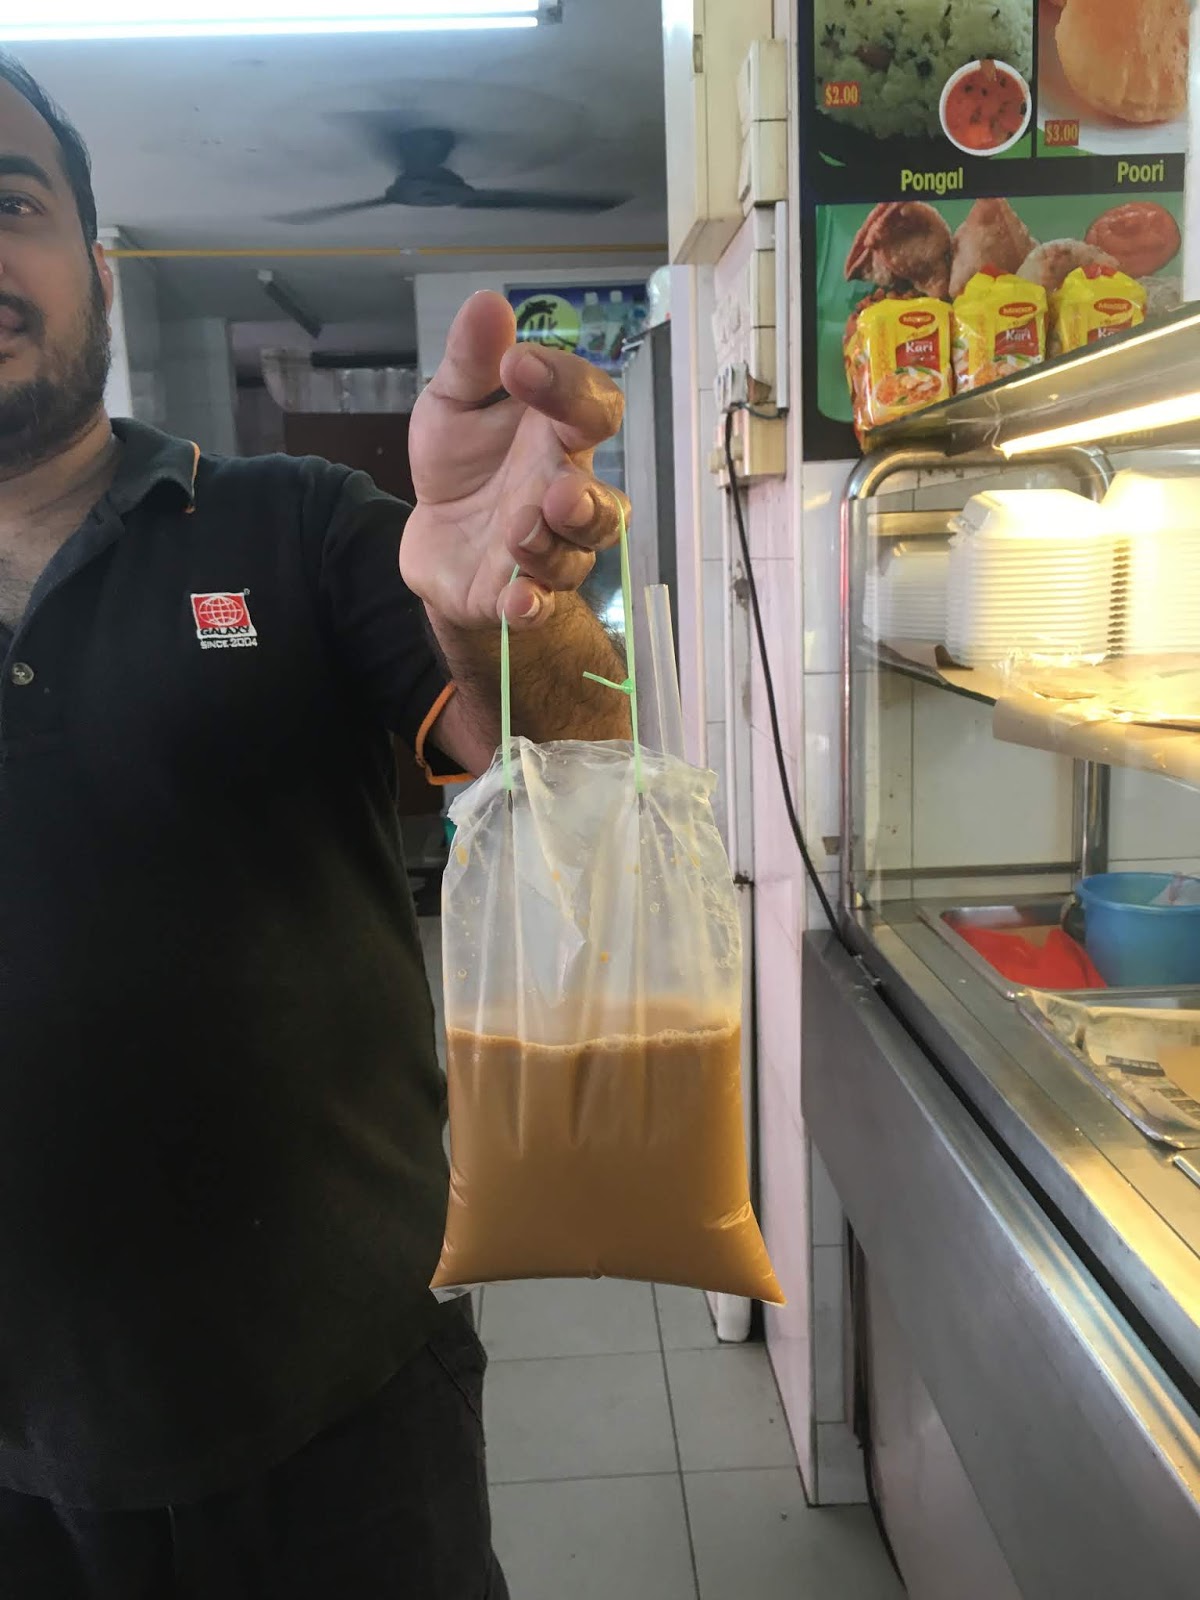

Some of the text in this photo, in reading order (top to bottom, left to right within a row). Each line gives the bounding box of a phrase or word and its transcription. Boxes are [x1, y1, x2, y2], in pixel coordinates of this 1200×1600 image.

[825, 82, 858, 105] $2.00
[1046, 122, 1078, 144] $3.00
[900, 167, 964, 195] Pongal
[1117, 159, 1164, 183] Poori
[1006, 328, 1031, 341] Kari
[906, 341, 933, 353] Kari
[200, 640, 230, 650] SINCE
